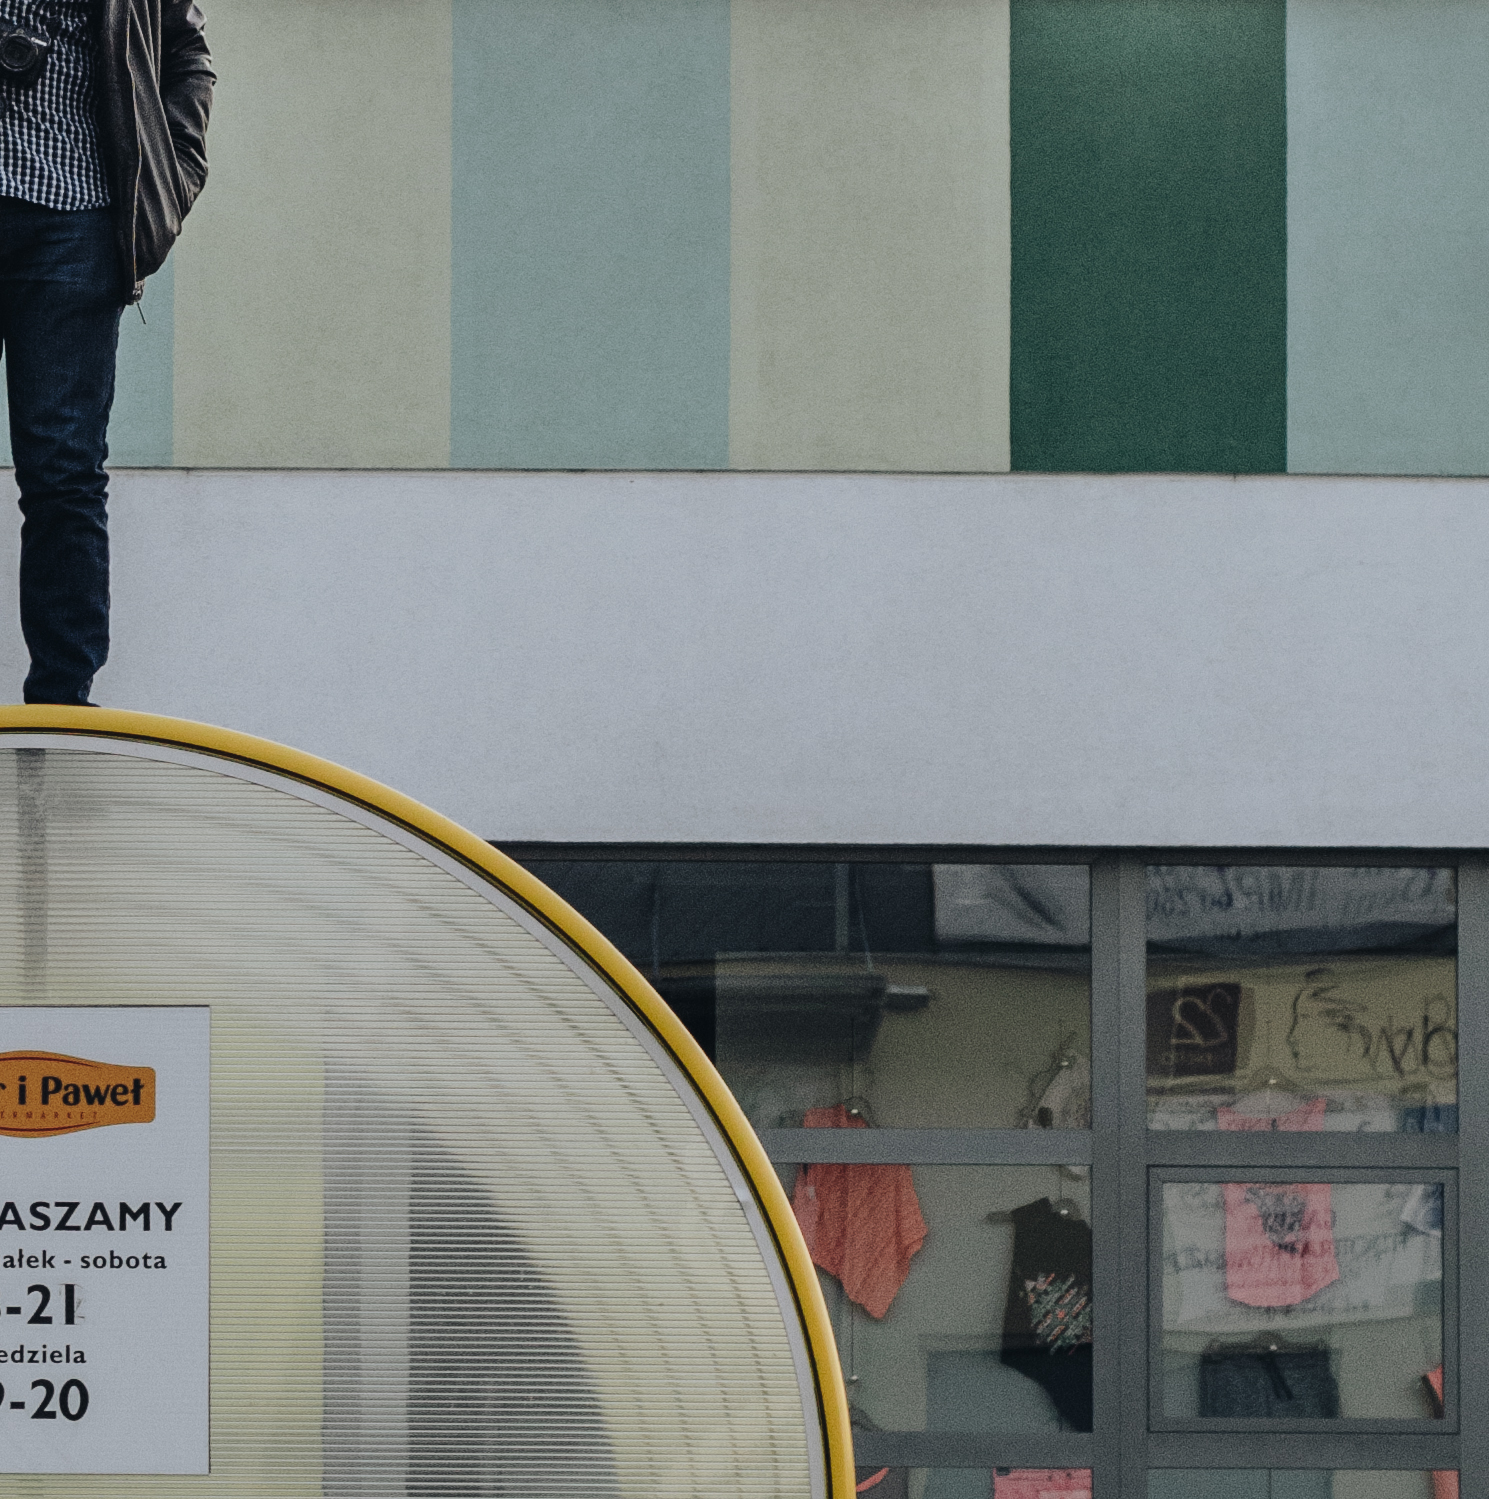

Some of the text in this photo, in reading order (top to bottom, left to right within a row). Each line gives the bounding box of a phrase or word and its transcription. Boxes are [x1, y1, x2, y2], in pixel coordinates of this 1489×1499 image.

[18, 1075, 27, 1106] i
[41, 1075, 145, 1107] Paweł
[80, 1250, 168, 1269] sobota
